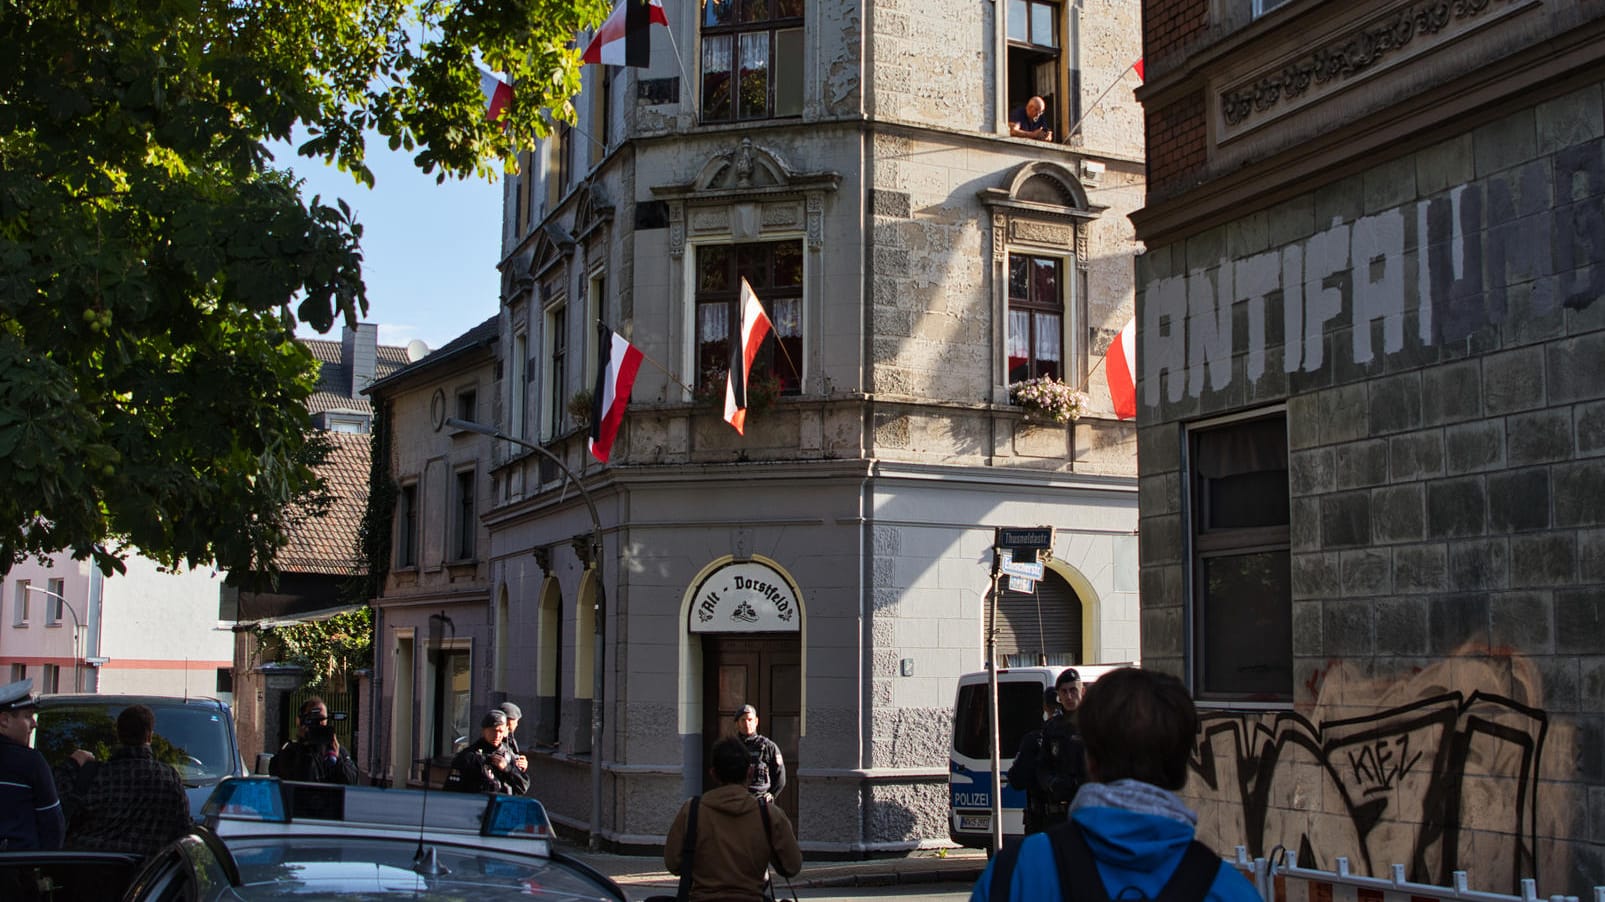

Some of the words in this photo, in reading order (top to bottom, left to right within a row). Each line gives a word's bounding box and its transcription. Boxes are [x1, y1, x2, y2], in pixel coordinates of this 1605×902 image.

[1144, 206, 1404, 408] ANTIFA
[701, 592, 720, 613] Alt
[734, 576, 788, 612] Dorstfeld
[1348, 734, 1423, 788] KIEZ
[954, 792, 989, 806] POLIZEI
